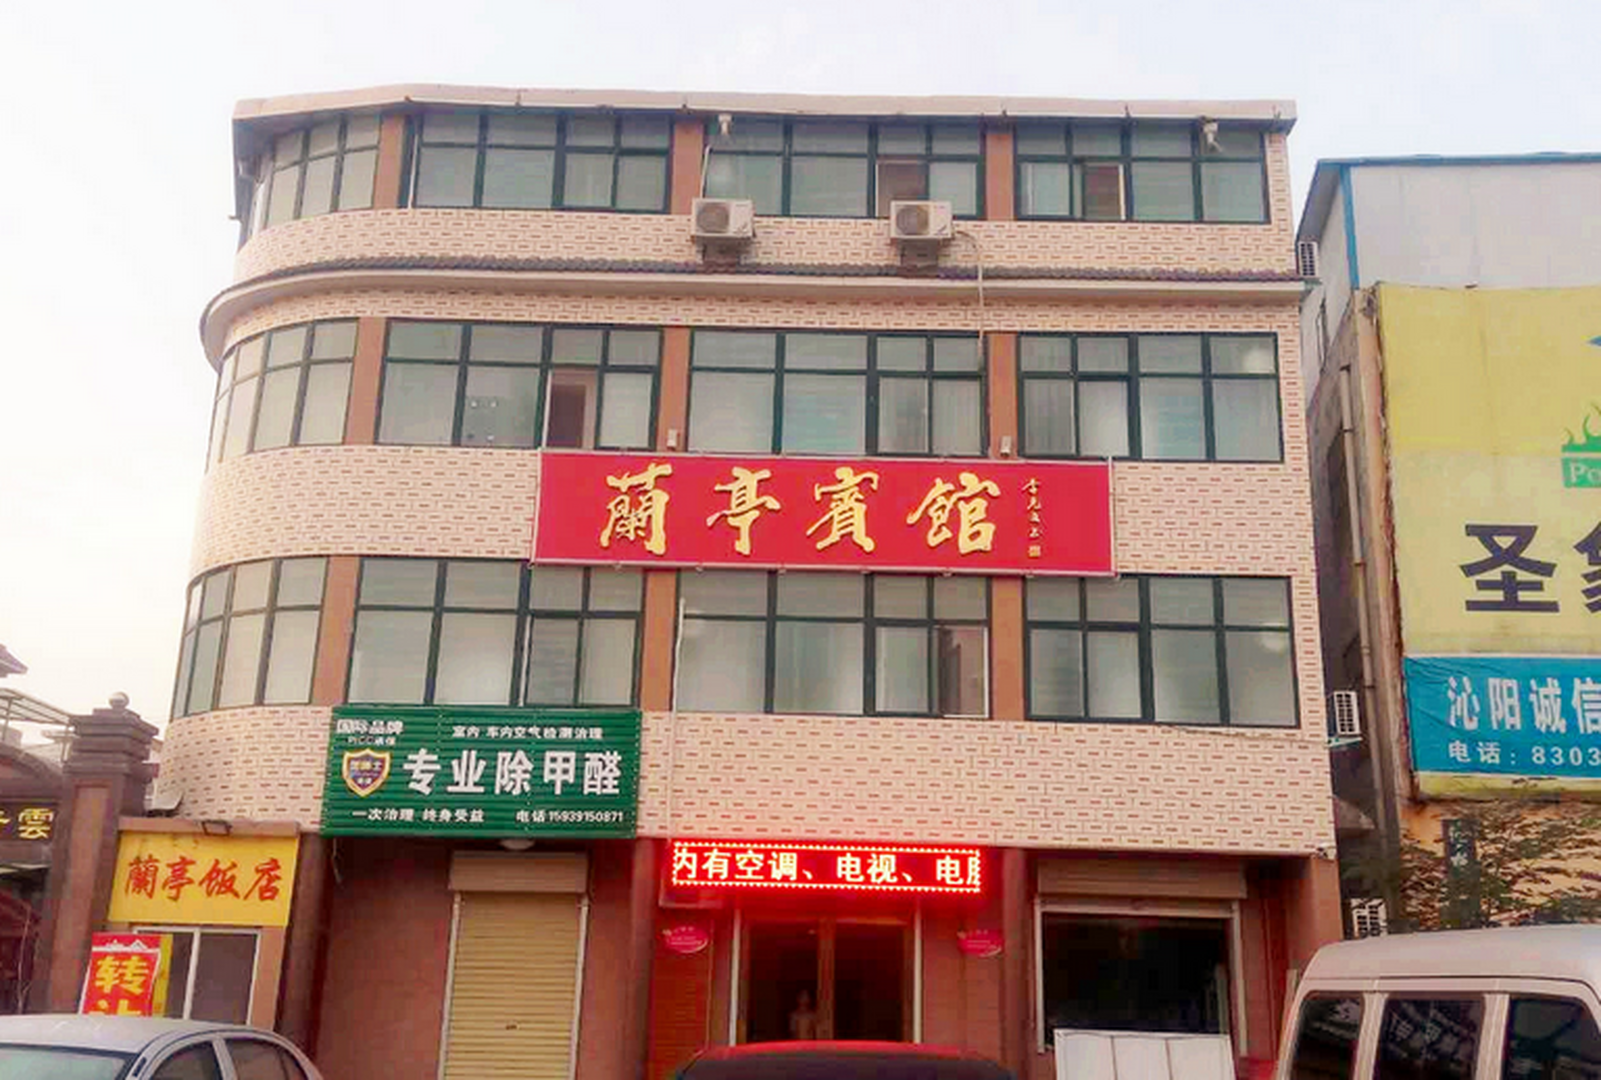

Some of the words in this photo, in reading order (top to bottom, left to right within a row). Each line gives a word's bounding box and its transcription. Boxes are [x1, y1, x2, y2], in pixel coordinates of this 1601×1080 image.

[599, 462, 1001, 557] 蘭亭賓館
[403, 748, 622, 796] 专业除甲醛
[352, 808, 414, 822] 一次治理
[422, 808, 485, 823] 终身受益
[125, 854, 283, 902] 蘭亭饭店
